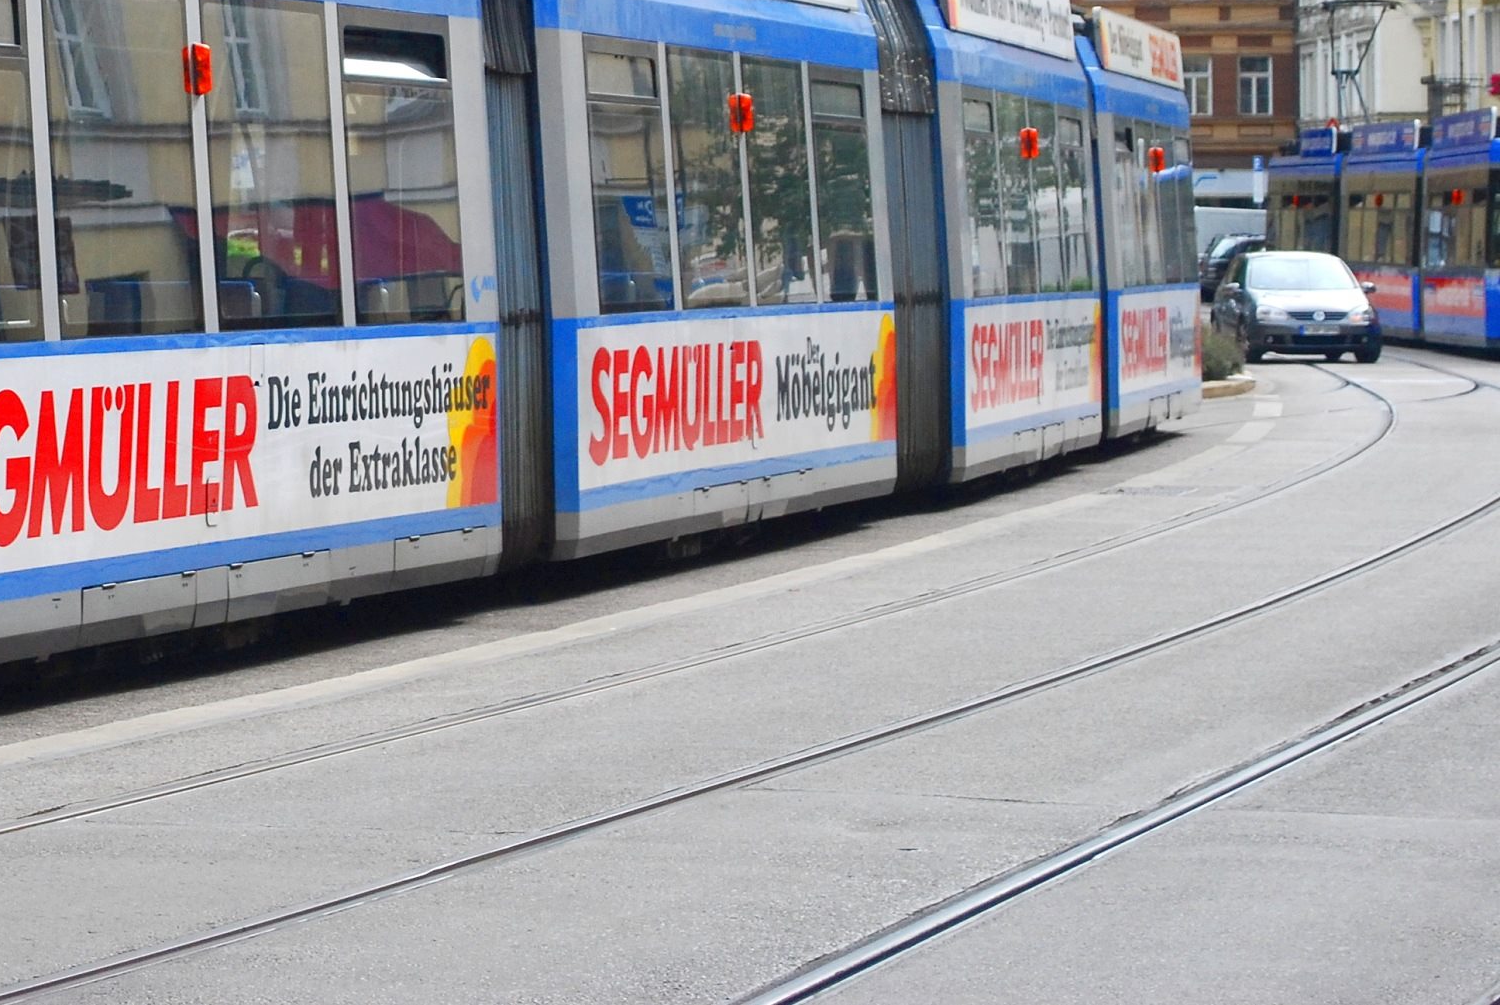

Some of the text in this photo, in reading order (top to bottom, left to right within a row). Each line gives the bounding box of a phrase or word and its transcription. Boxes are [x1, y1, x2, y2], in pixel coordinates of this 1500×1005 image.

[268, 362, 491, 430] Die Einrichtungshäuser
[589, 339, 764, 466] SEGMÜLLER
[776, 351, 877, 432] Möbelgigant
[310, 436, 457, 498] der Extraklasse
